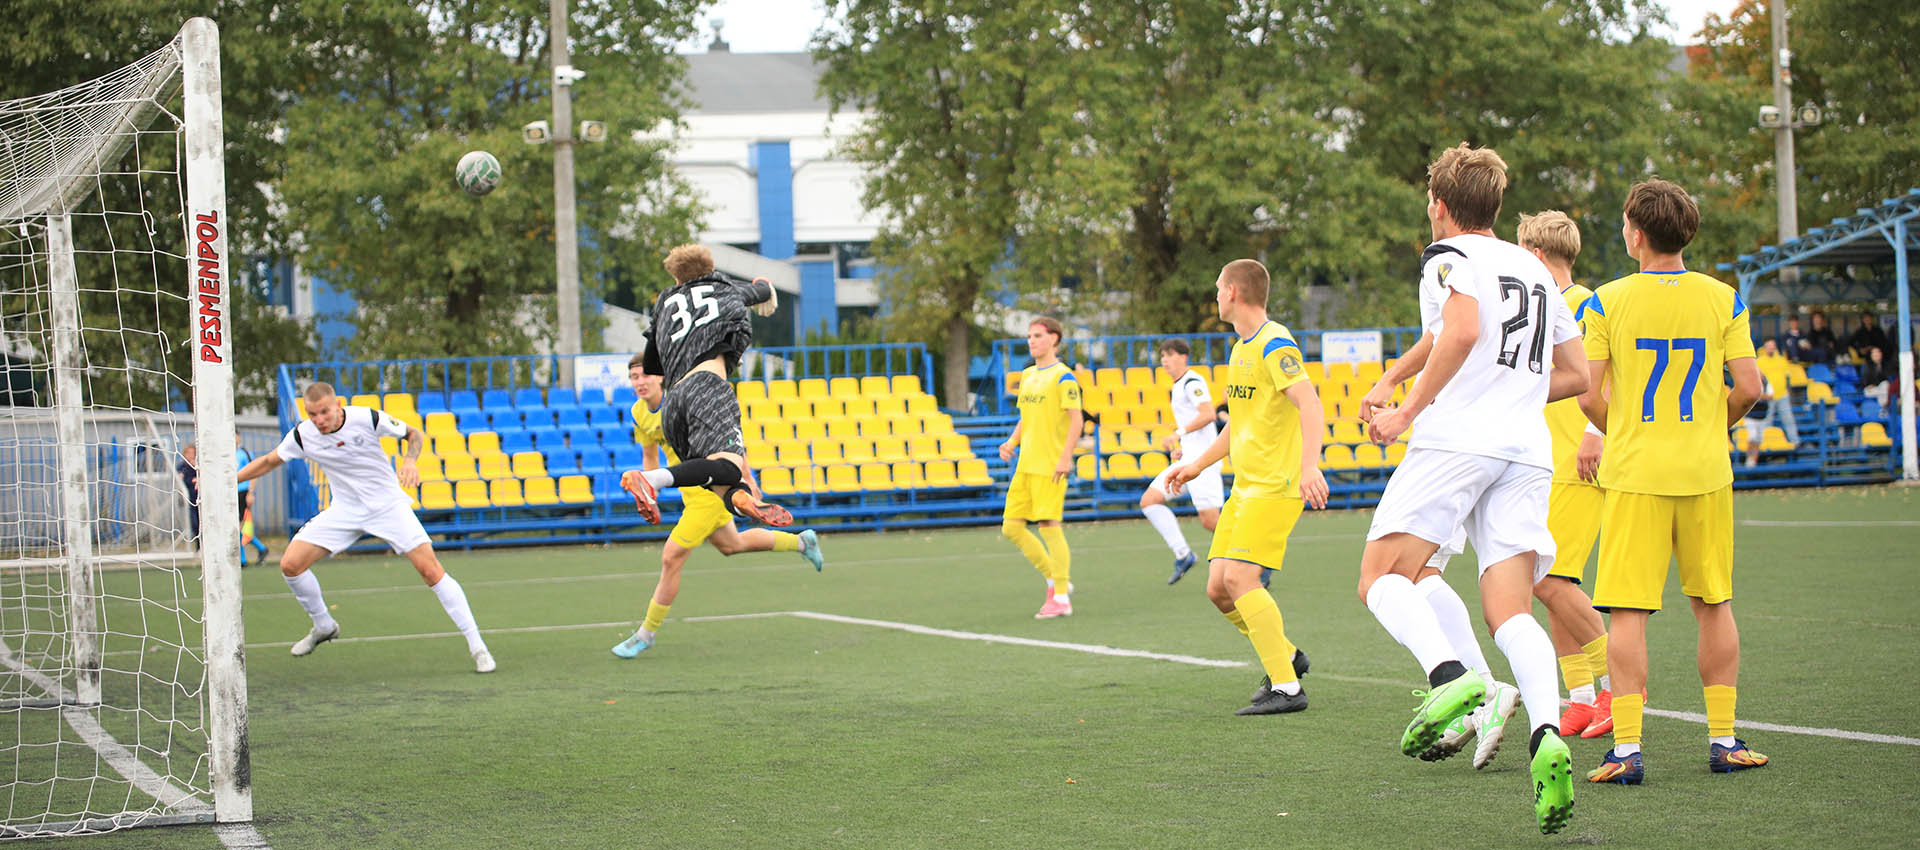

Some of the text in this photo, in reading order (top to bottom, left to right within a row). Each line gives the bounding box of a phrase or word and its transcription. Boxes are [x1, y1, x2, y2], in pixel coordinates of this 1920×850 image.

[196, 210, 223, 363] PESMENPOL
[664, 285, 720, 342] 35
[1496, 275, 1547, 374] 21
[1635, 338, 1706, 422] 77
